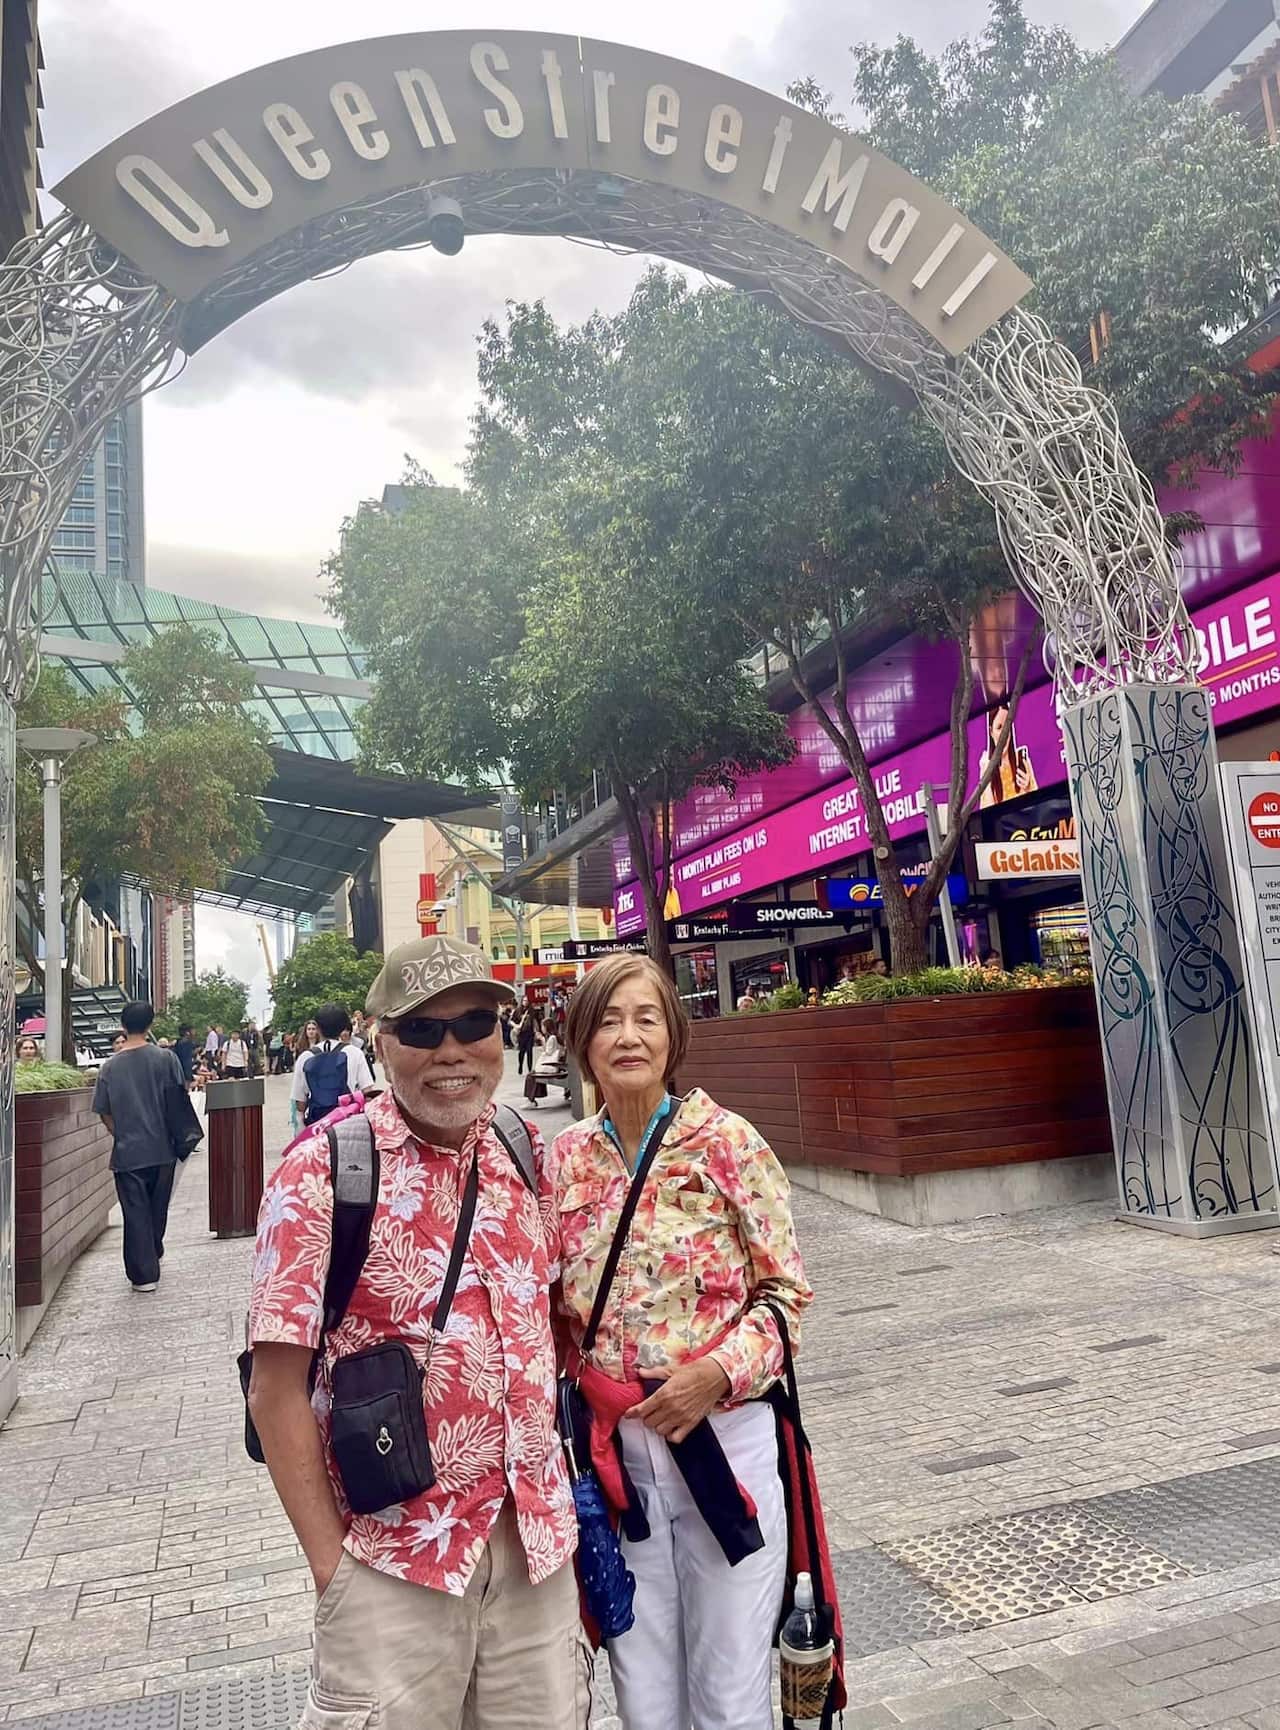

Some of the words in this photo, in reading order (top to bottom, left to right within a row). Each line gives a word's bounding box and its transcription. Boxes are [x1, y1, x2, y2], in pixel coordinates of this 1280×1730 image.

[1194, 595, 1277, 676] BILE
[1219, 666, 1280, 705] MONTHS
[822, 788, 860, 821] GREAT
[875, 769, 901, 799] LUE
[1263, 802, 1278, 813] NO
[682, 858, 705, 881] MONTH
[705, 849, 723, 870] PLAN
[723, 840, 743, 862] FEES
[743, 834, 755, 854] ON
[755, 828, 767, 848] US
[808, 815, 862, 855] INTERNET
[756, 906, 834, 922] SHOWGIRLS
